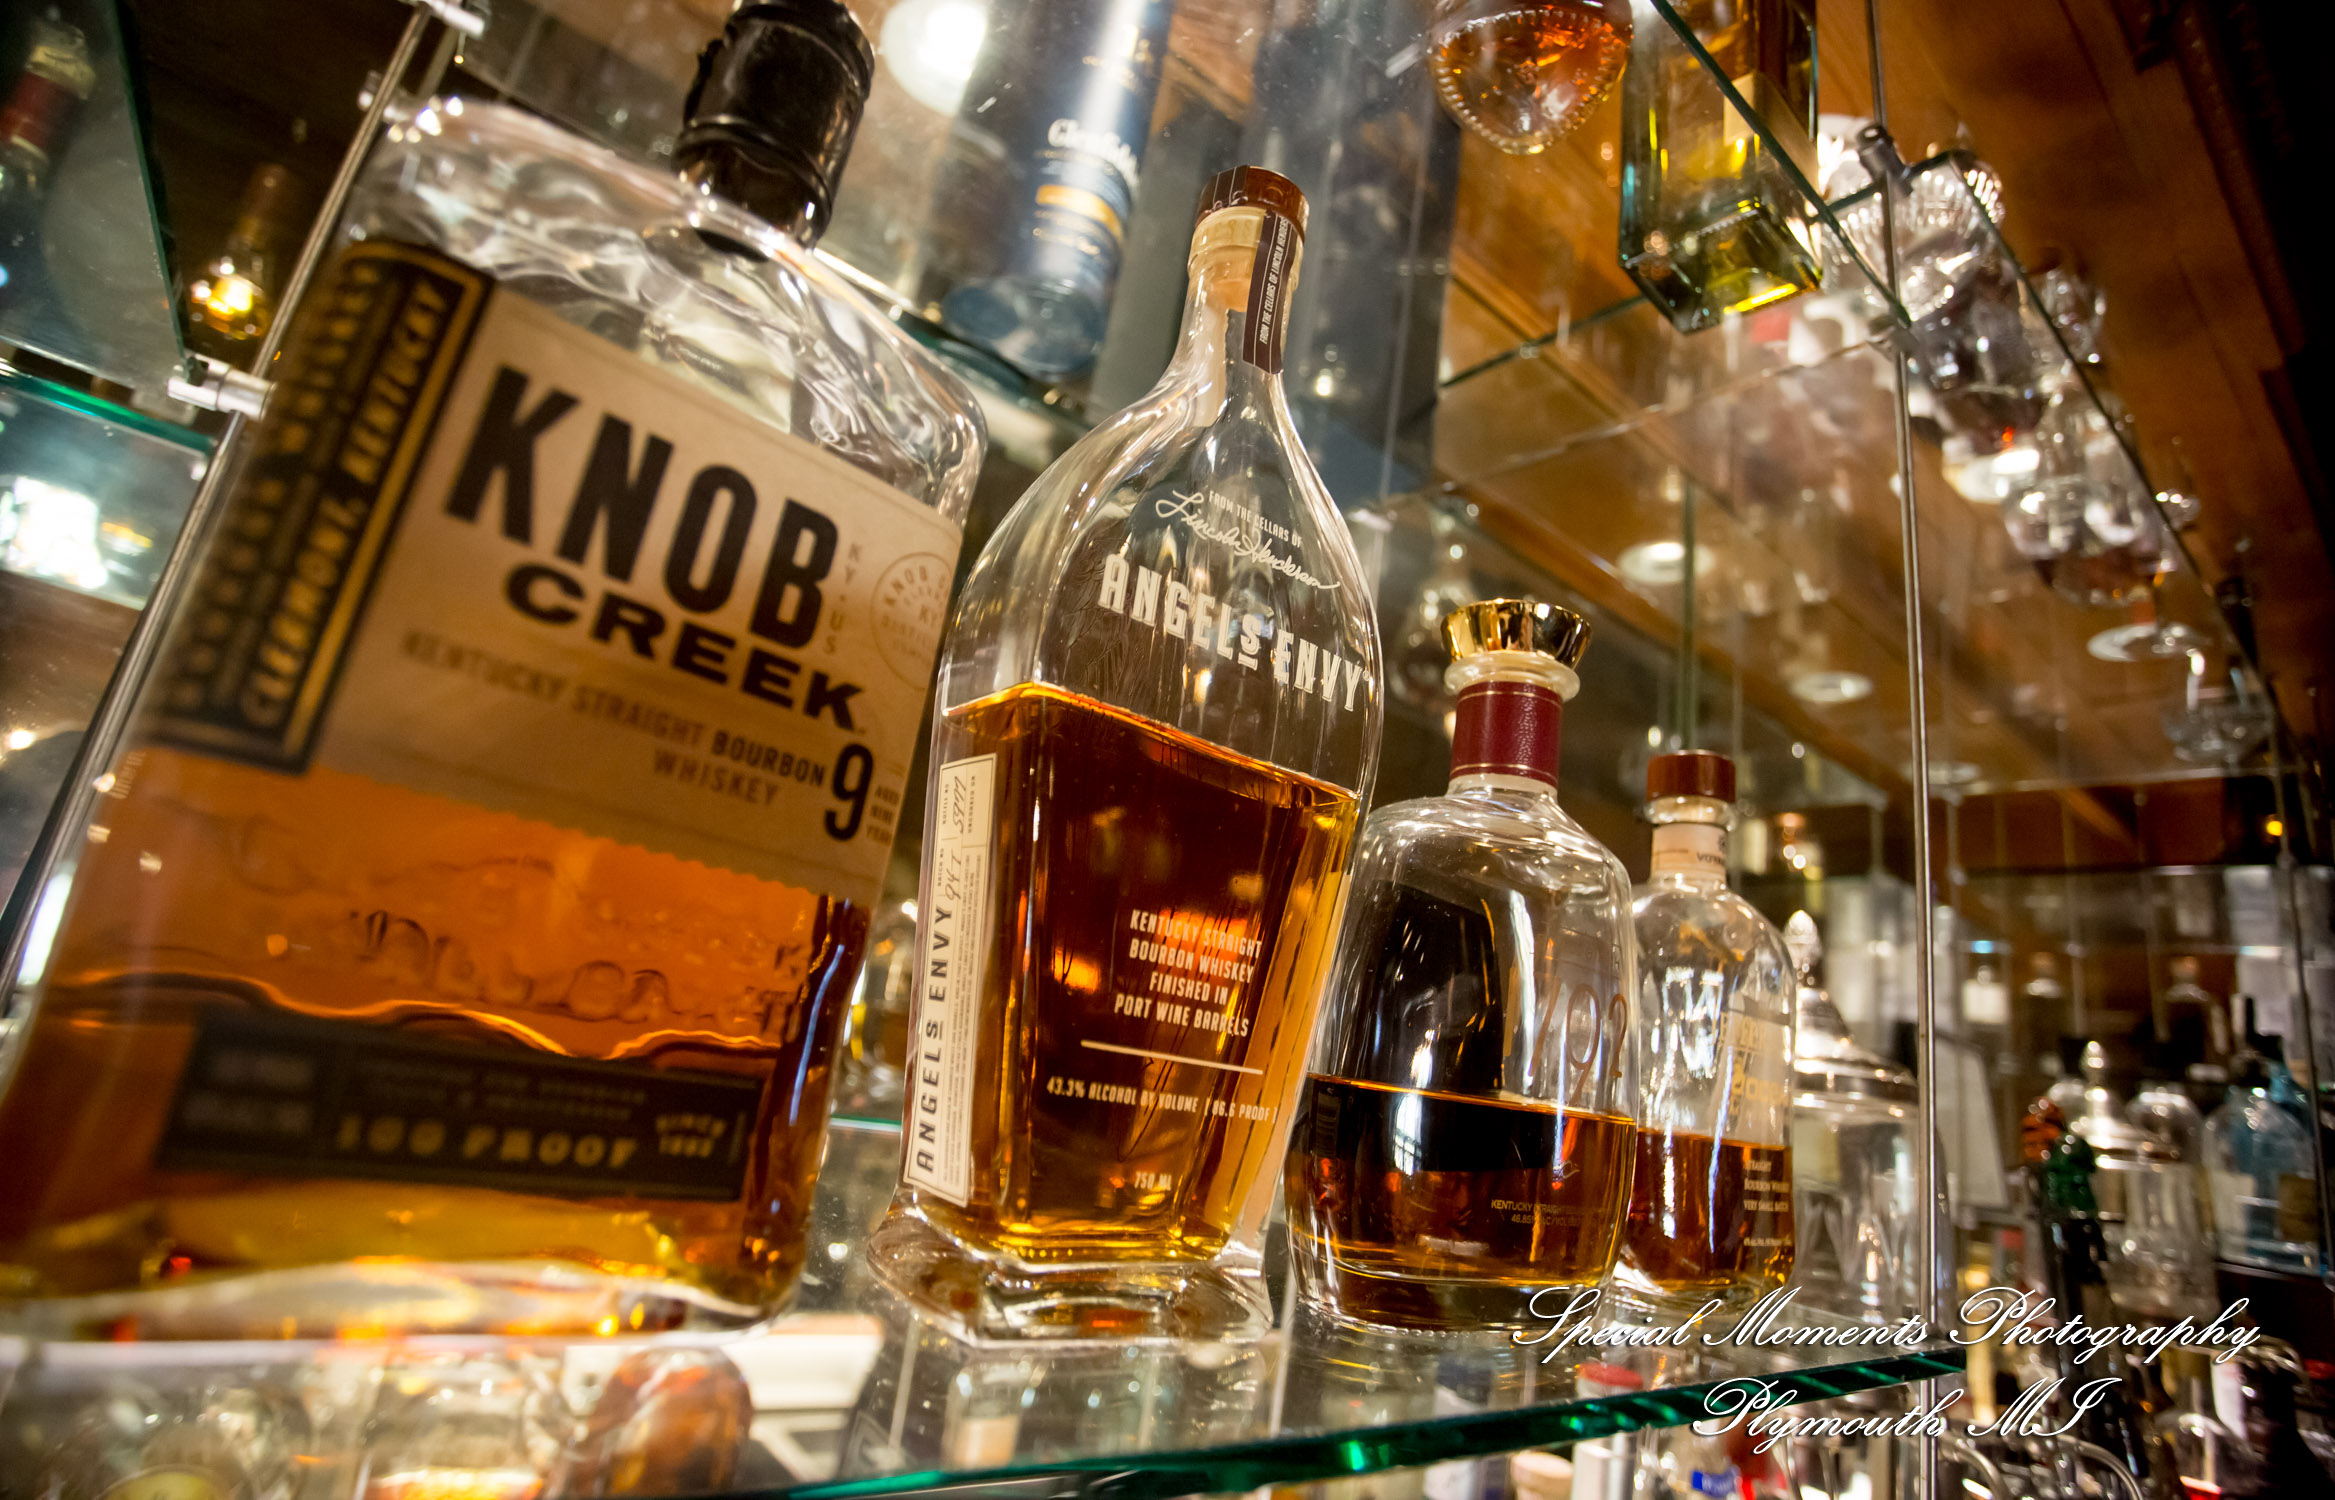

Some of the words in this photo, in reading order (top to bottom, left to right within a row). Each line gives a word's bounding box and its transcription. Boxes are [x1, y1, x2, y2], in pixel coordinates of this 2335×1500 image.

[1259, 324, 1270, 345] FROM
[1265, 283, 1276, 313] CELLARS
[1271, 246, 1285, 274] LINCOLN
[444, 363, 838, 650] KNOB
[1208, 490, 1233, 513] FROM
[1236, 505, 1252, 522] THE
[1253, 513, 1290, 542] CELLARS
[1291, 535, 1302, 549] OF
[504, 563, 863, 732] CREEK
[1098, 553, 1262, 671] ANGELS
[1273, 628, 1363, 712] ENVY
[403, 630, 566, 701] KENTUCKY
[572, 684, 707, 750] STRAIGHT
[712, 730, 826, 788] BOURBON
[653, 748, 779, 808] WHISKEY
[824, 743, 875, 841] 9
[929, 908, 952, 1002] ENVY
[1129, 938, 1194, 971] BOURBON
[1199, 957, 1254, 984] WHISKEY
[1130, 909, 1200, 944] KENTUCKY
[1203, 929, 1262, 959] STRAIGHT
[1114, 993, 1152, 1018] PORT
[1156, 1002, 1190, 1027] WINE
[1193, 1009, 1250, 1037] BARRELS
[1149, 972, 1210, 1002] FINISHED
[1214, 986, 1229, 1006] IN
[917, 1019, 943, 1172] ANGELS
[1047, 1076, 1085, 1098] 43.3%
[1088, 1082, 1137, 1105] ALCOHOL
[1140, 1091, 1155, 1107] BY
[1158, 1093, 1198, 1113] VOLUME
[1239, 1104, 1271, 1122] PROOF
[460, 1125, 638, 1168] PROOF
[1134, 1172, 1157, 1190] 750
[1158, 1175, 1172, 1191] ML
[1491, 1199, 1533, 1212] KENTUCKY
